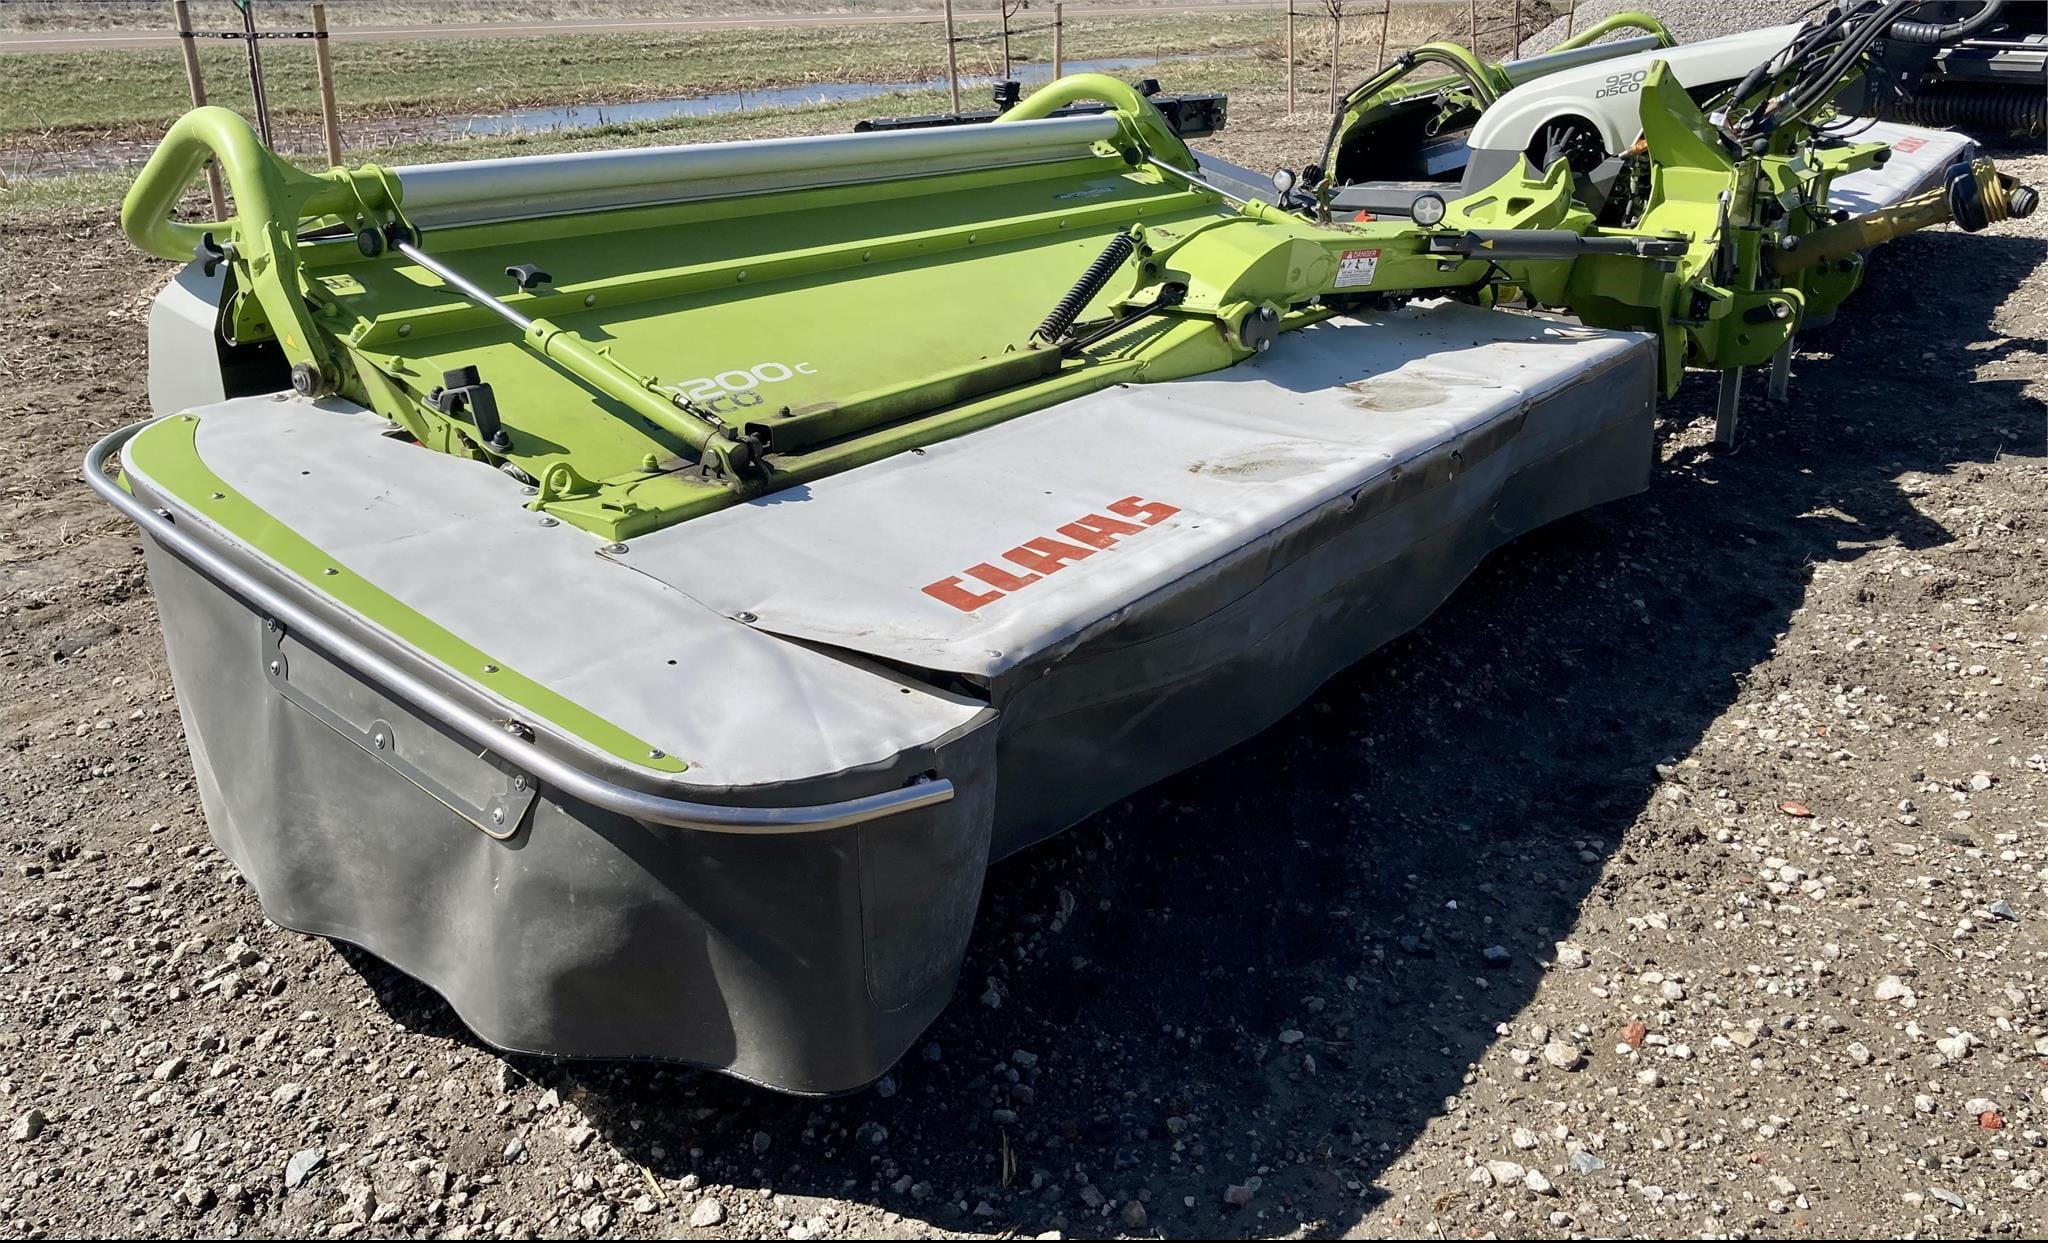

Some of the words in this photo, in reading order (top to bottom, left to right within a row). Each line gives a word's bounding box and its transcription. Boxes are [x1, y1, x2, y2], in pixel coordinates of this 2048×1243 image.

[1595, 83, 1640, 99] DISCO
[1353, 250, 1377, 258] DANGER
[921, 495, 1182, 613] CLAAS
